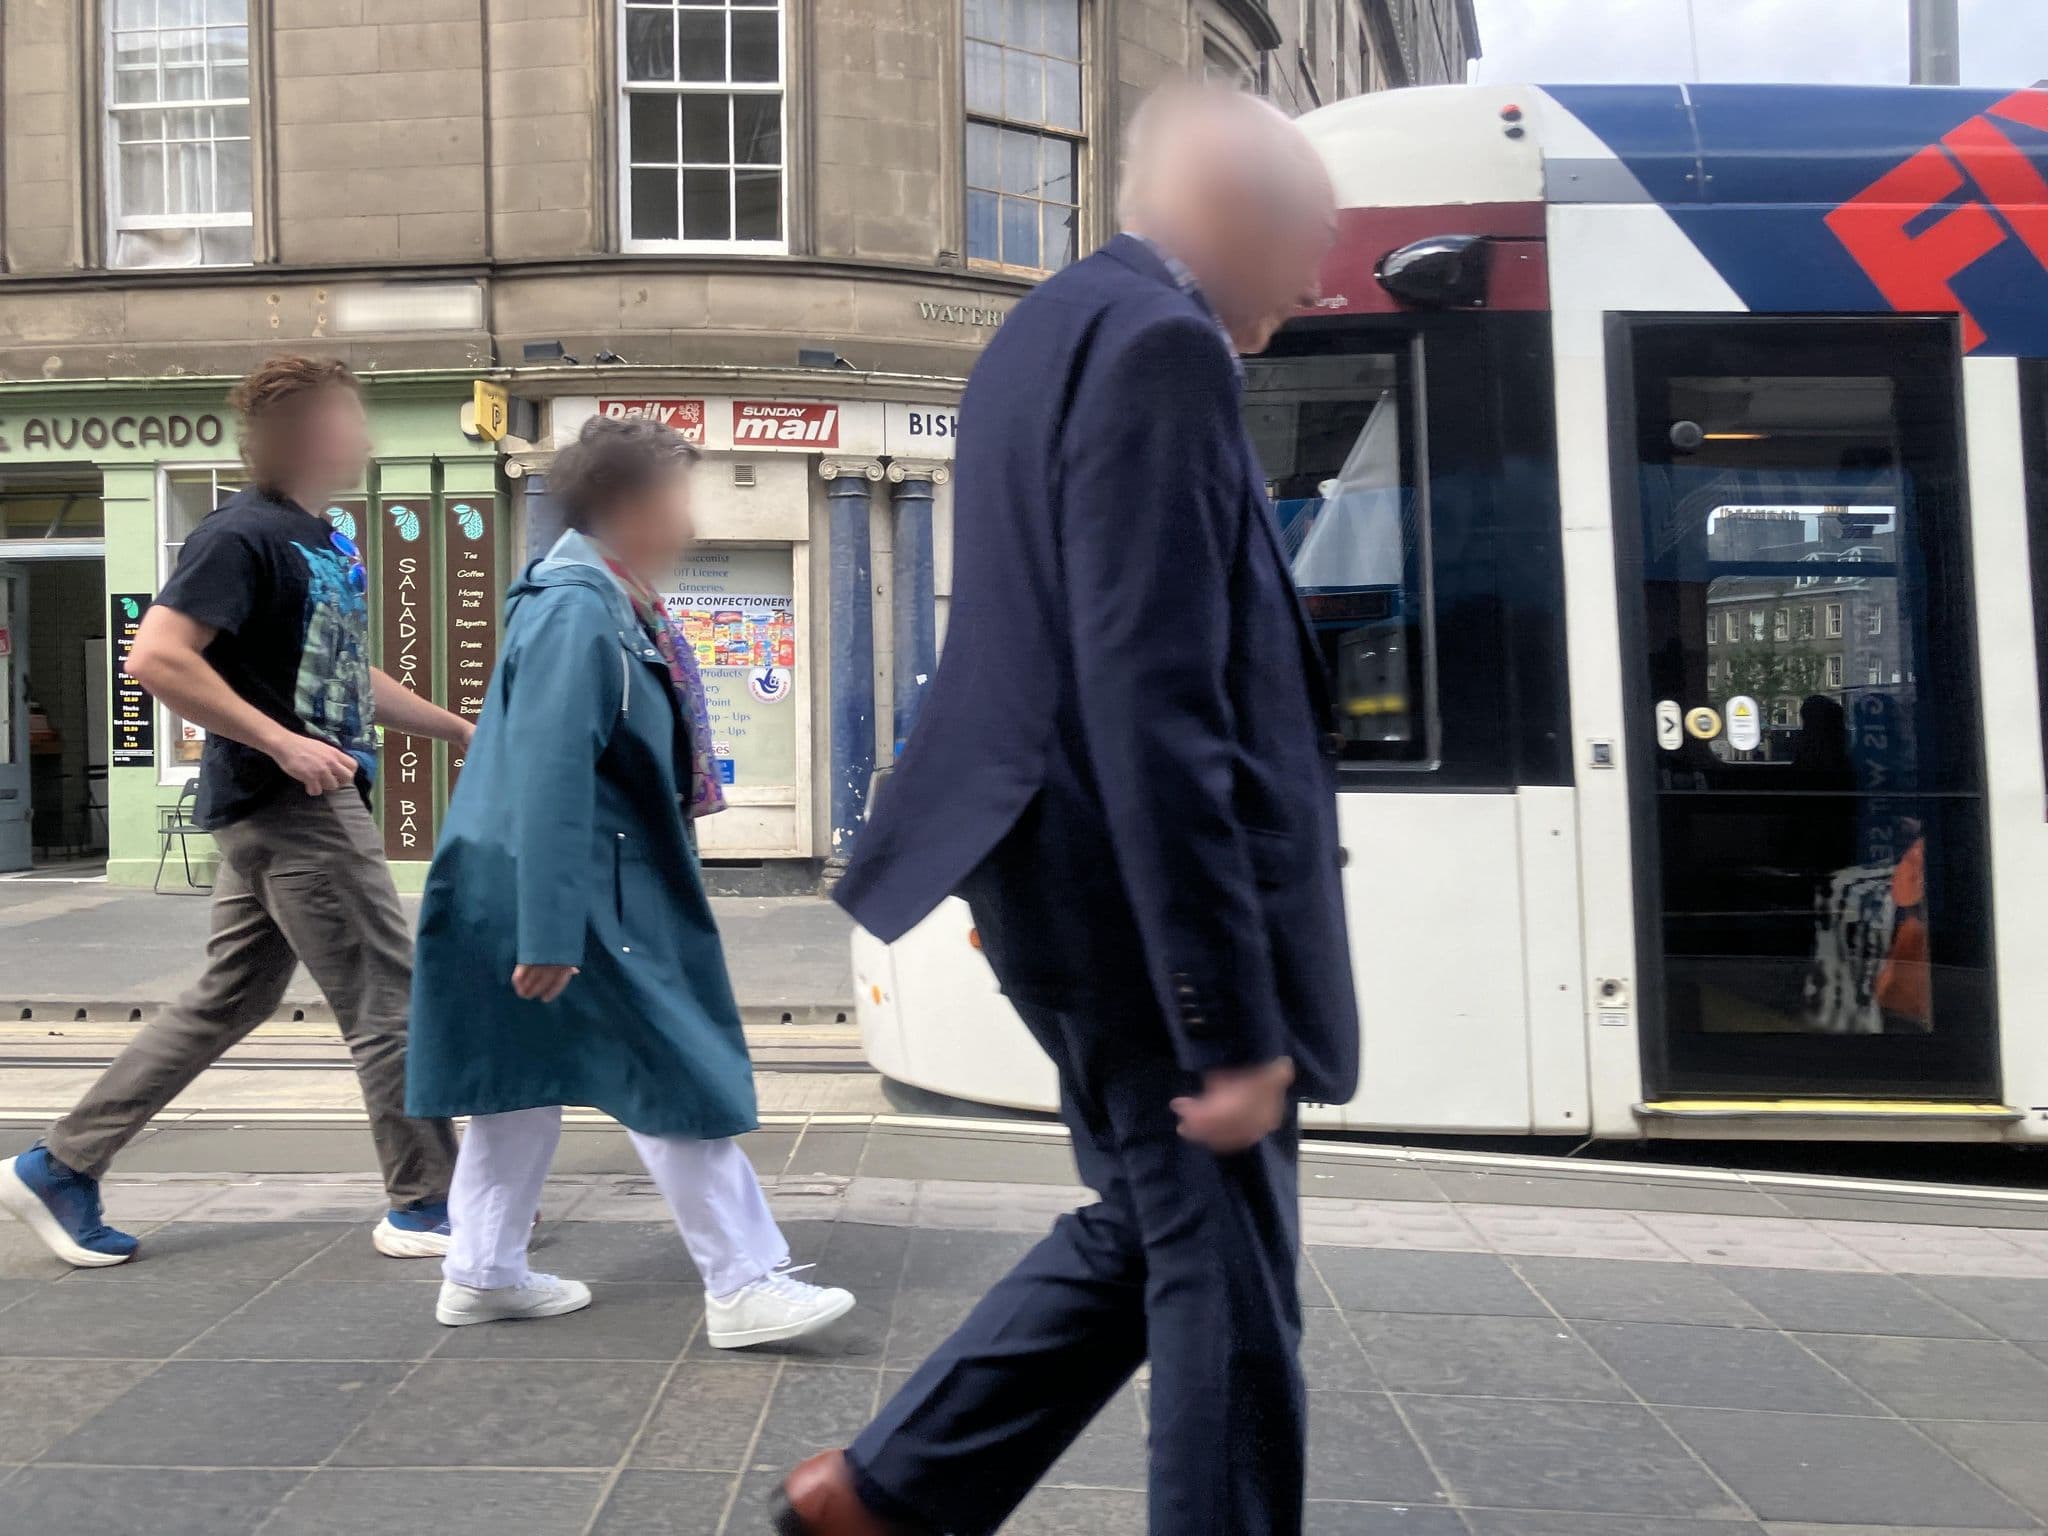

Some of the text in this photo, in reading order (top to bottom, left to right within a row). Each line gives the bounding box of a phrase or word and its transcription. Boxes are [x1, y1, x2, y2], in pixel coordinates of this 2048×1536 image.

[1823, 88, 2048, 355] FI
[605, 402, 677, 424] Daily
[742, 406, 806, 417] SUNDAY
[735, 409, 837, 442] mail
[23, 414, 223, 449] AVOCADO
[456, 569, 485, 578] Coffee
[692, 567, 729, 578] Licence
[678, 582, 725, 592] Groceries
[668, 597, 793, 608] AND CONFECTIONERY
[398, 557, 418, 848] SALAD/SAICH BAR
[732, 711, 752, 723] Ups
[728, 726, 747, 737] Ups
